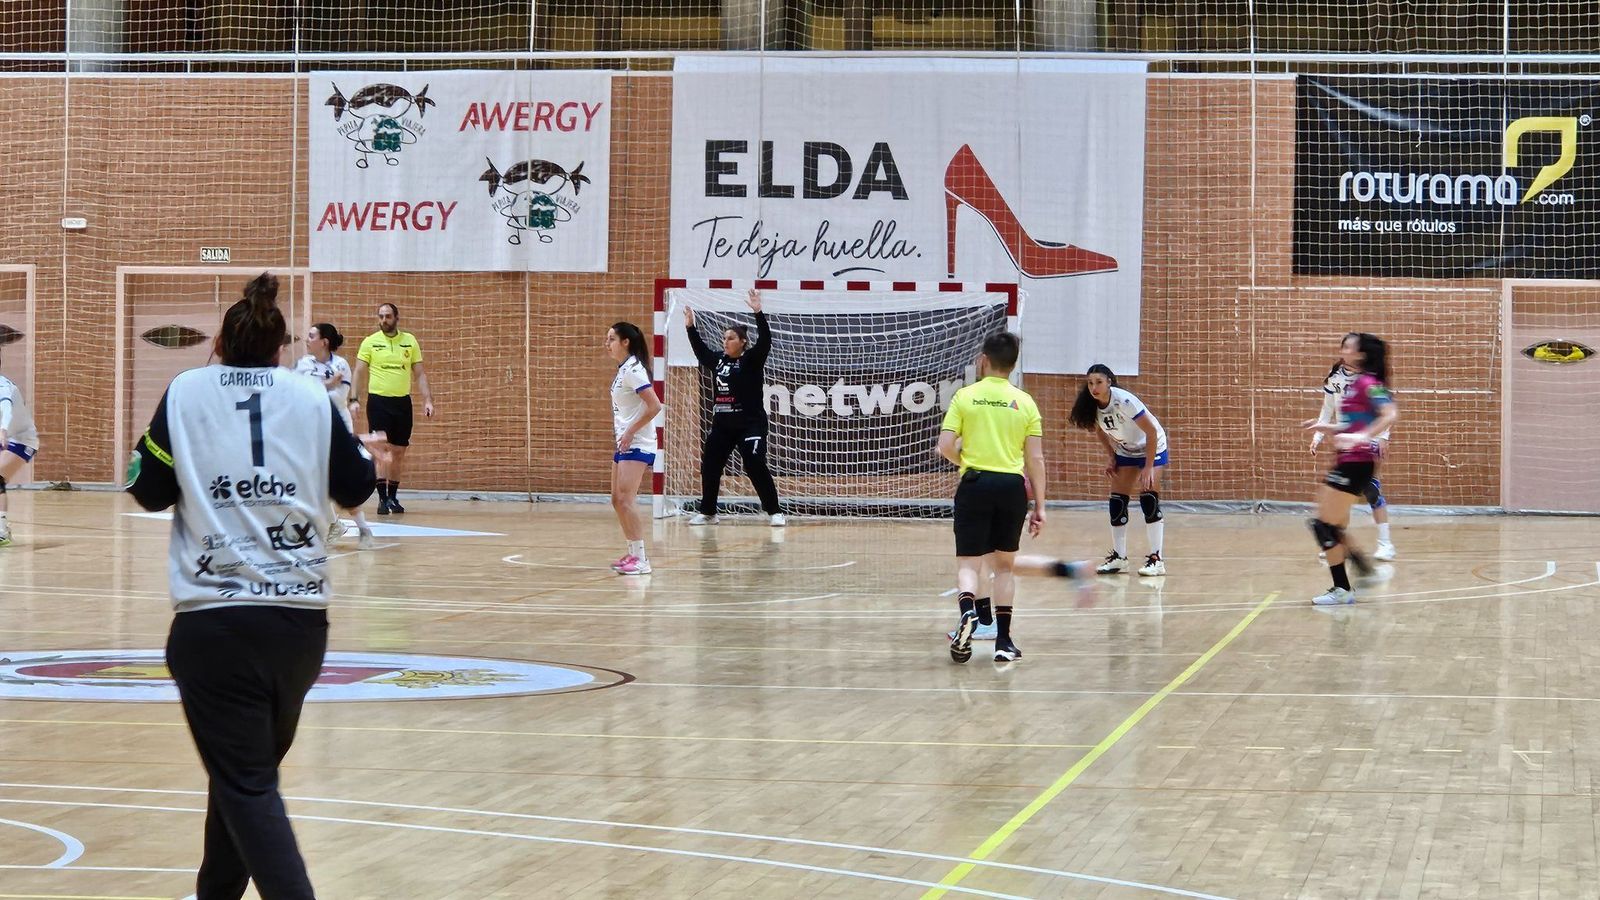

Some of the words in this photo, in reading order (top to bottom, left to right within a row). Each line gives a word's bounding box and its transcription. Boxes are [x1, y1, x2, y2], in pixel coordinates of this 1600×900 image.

[459, 102, 603, 132] AWERGY
[705, 140, 909, 200] ELDA
[316, 201, 458, 231] AWERGY
[1338, 217, 1371, 231] más
[1375, 219, 1402, 234] que
[1406, 218, 1456, 233] rótulos
[202, 248, 229, 261] SALIDA
[692, 215, 743, 268] Te
[737, 219, 807, 279] deja
[812, 219, 922, 262] huella.
[763, 365, 977, 417] networ
[236, 393, 265, 468] 1
[236, 474, 296, 499] elche
